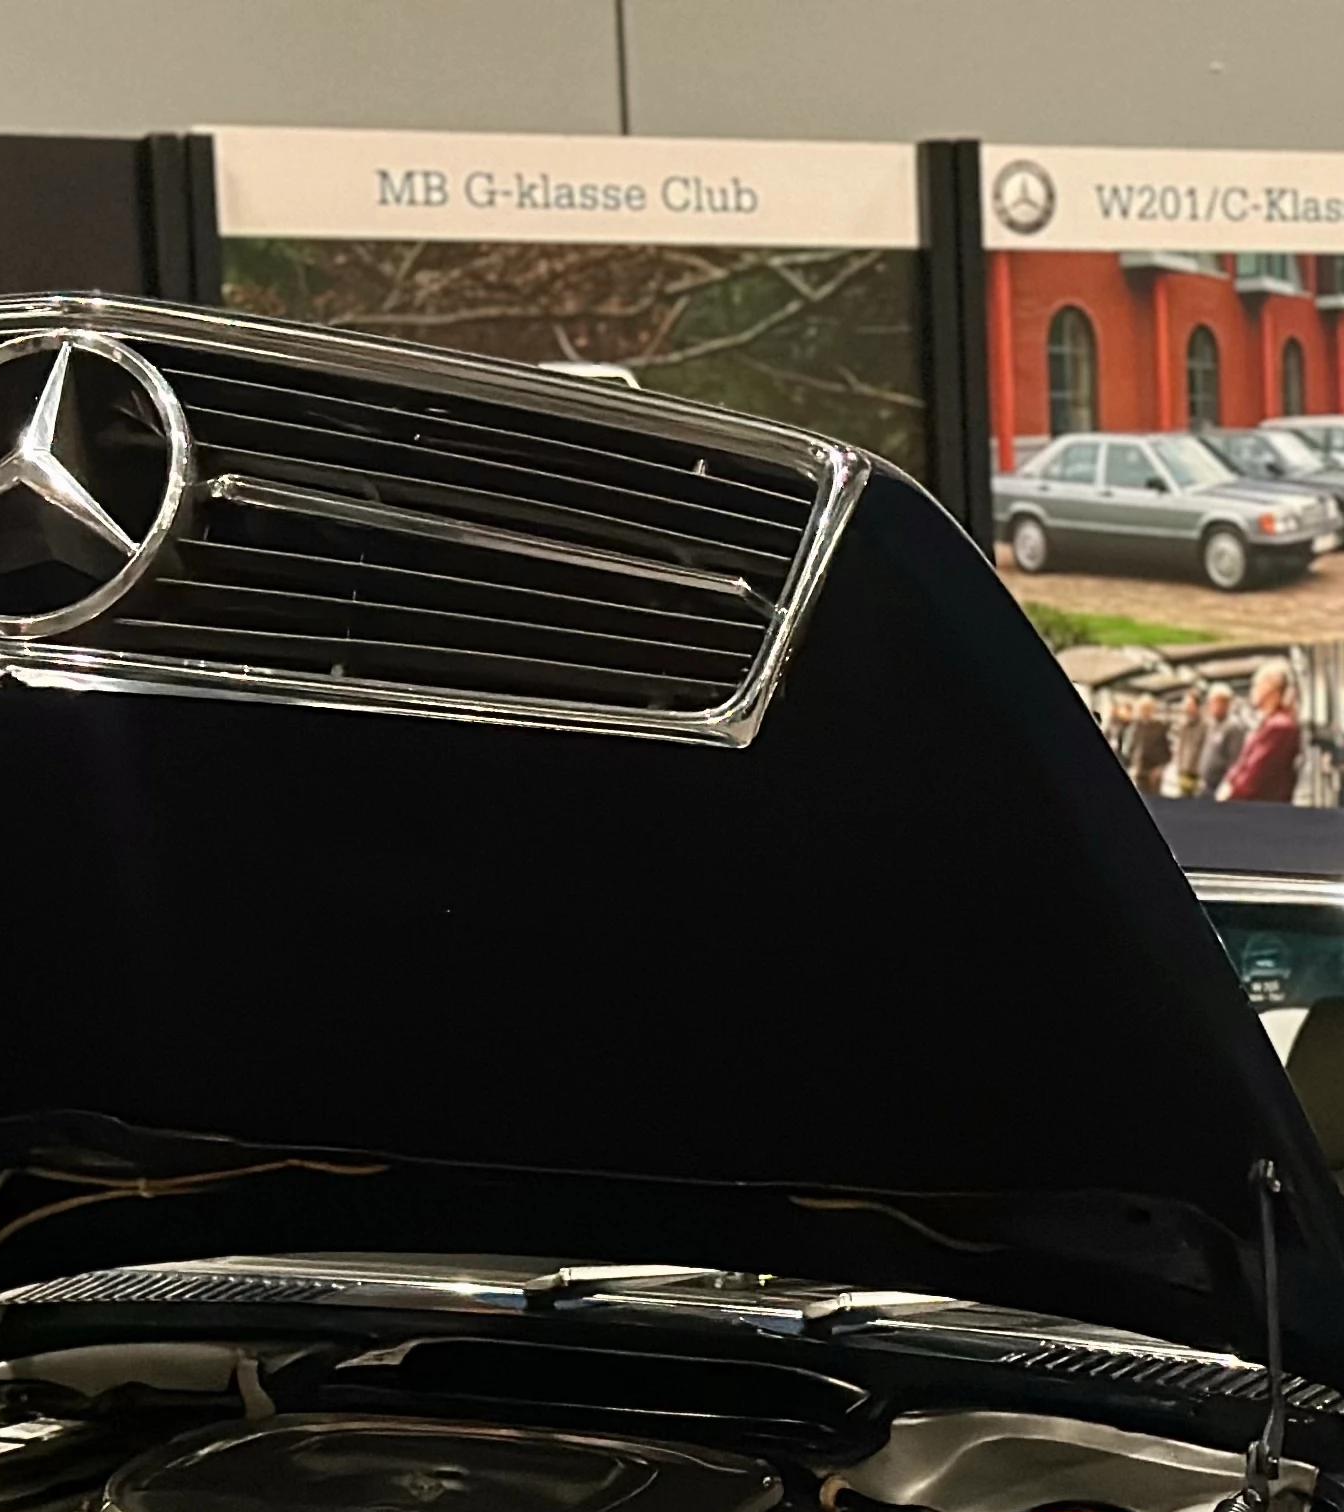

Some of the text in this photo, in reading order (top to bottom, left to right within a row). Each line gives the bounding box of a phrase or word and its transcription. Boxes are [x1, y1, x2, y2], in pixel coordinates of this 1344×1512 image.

[375, 168, 758, 214] MB G-klasse Club
